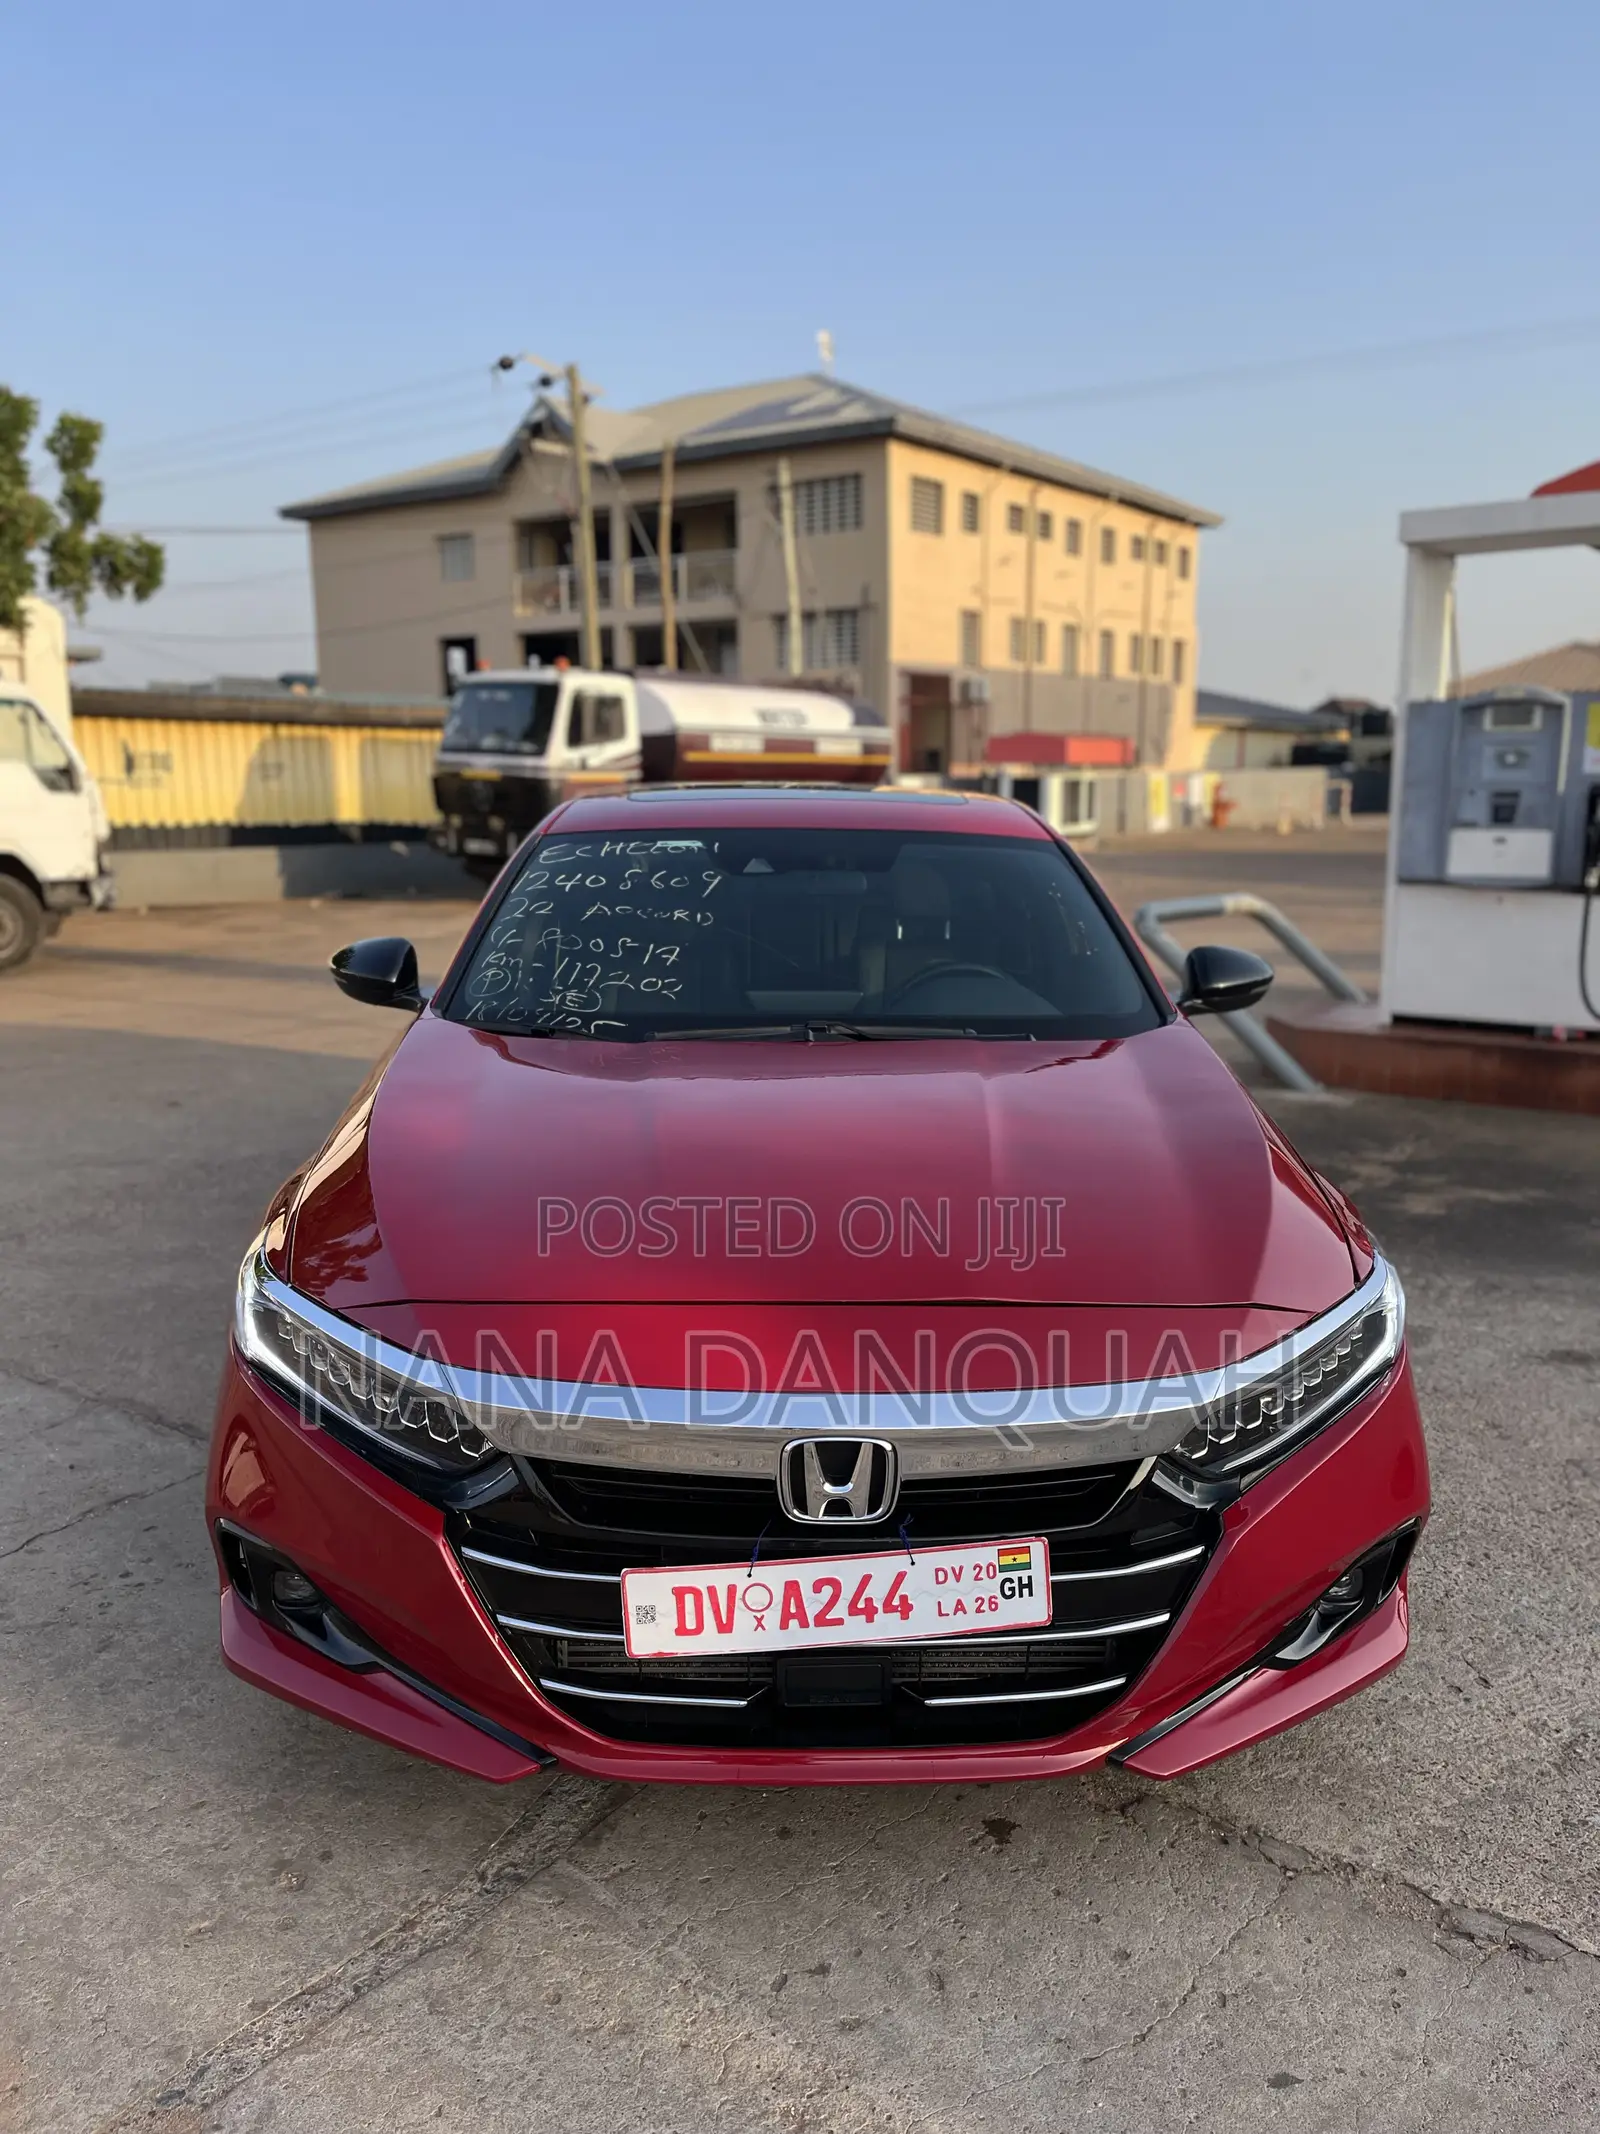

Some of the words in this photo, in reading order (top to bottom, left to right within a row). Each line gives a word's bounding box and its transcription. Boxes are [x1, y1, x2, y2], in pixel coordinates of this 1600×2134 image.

[935, 1564, 964, 1586] DV
[973, 1561, 998, 1582] 20
[999, 1576, 1034, 1601] GH
[671, 1584, 738, 1637] DV
[779, 1570, 914, 1631] A244
[937, 1598, 967, 1617] LA
[975, 1595, 1000, 1614] 26
